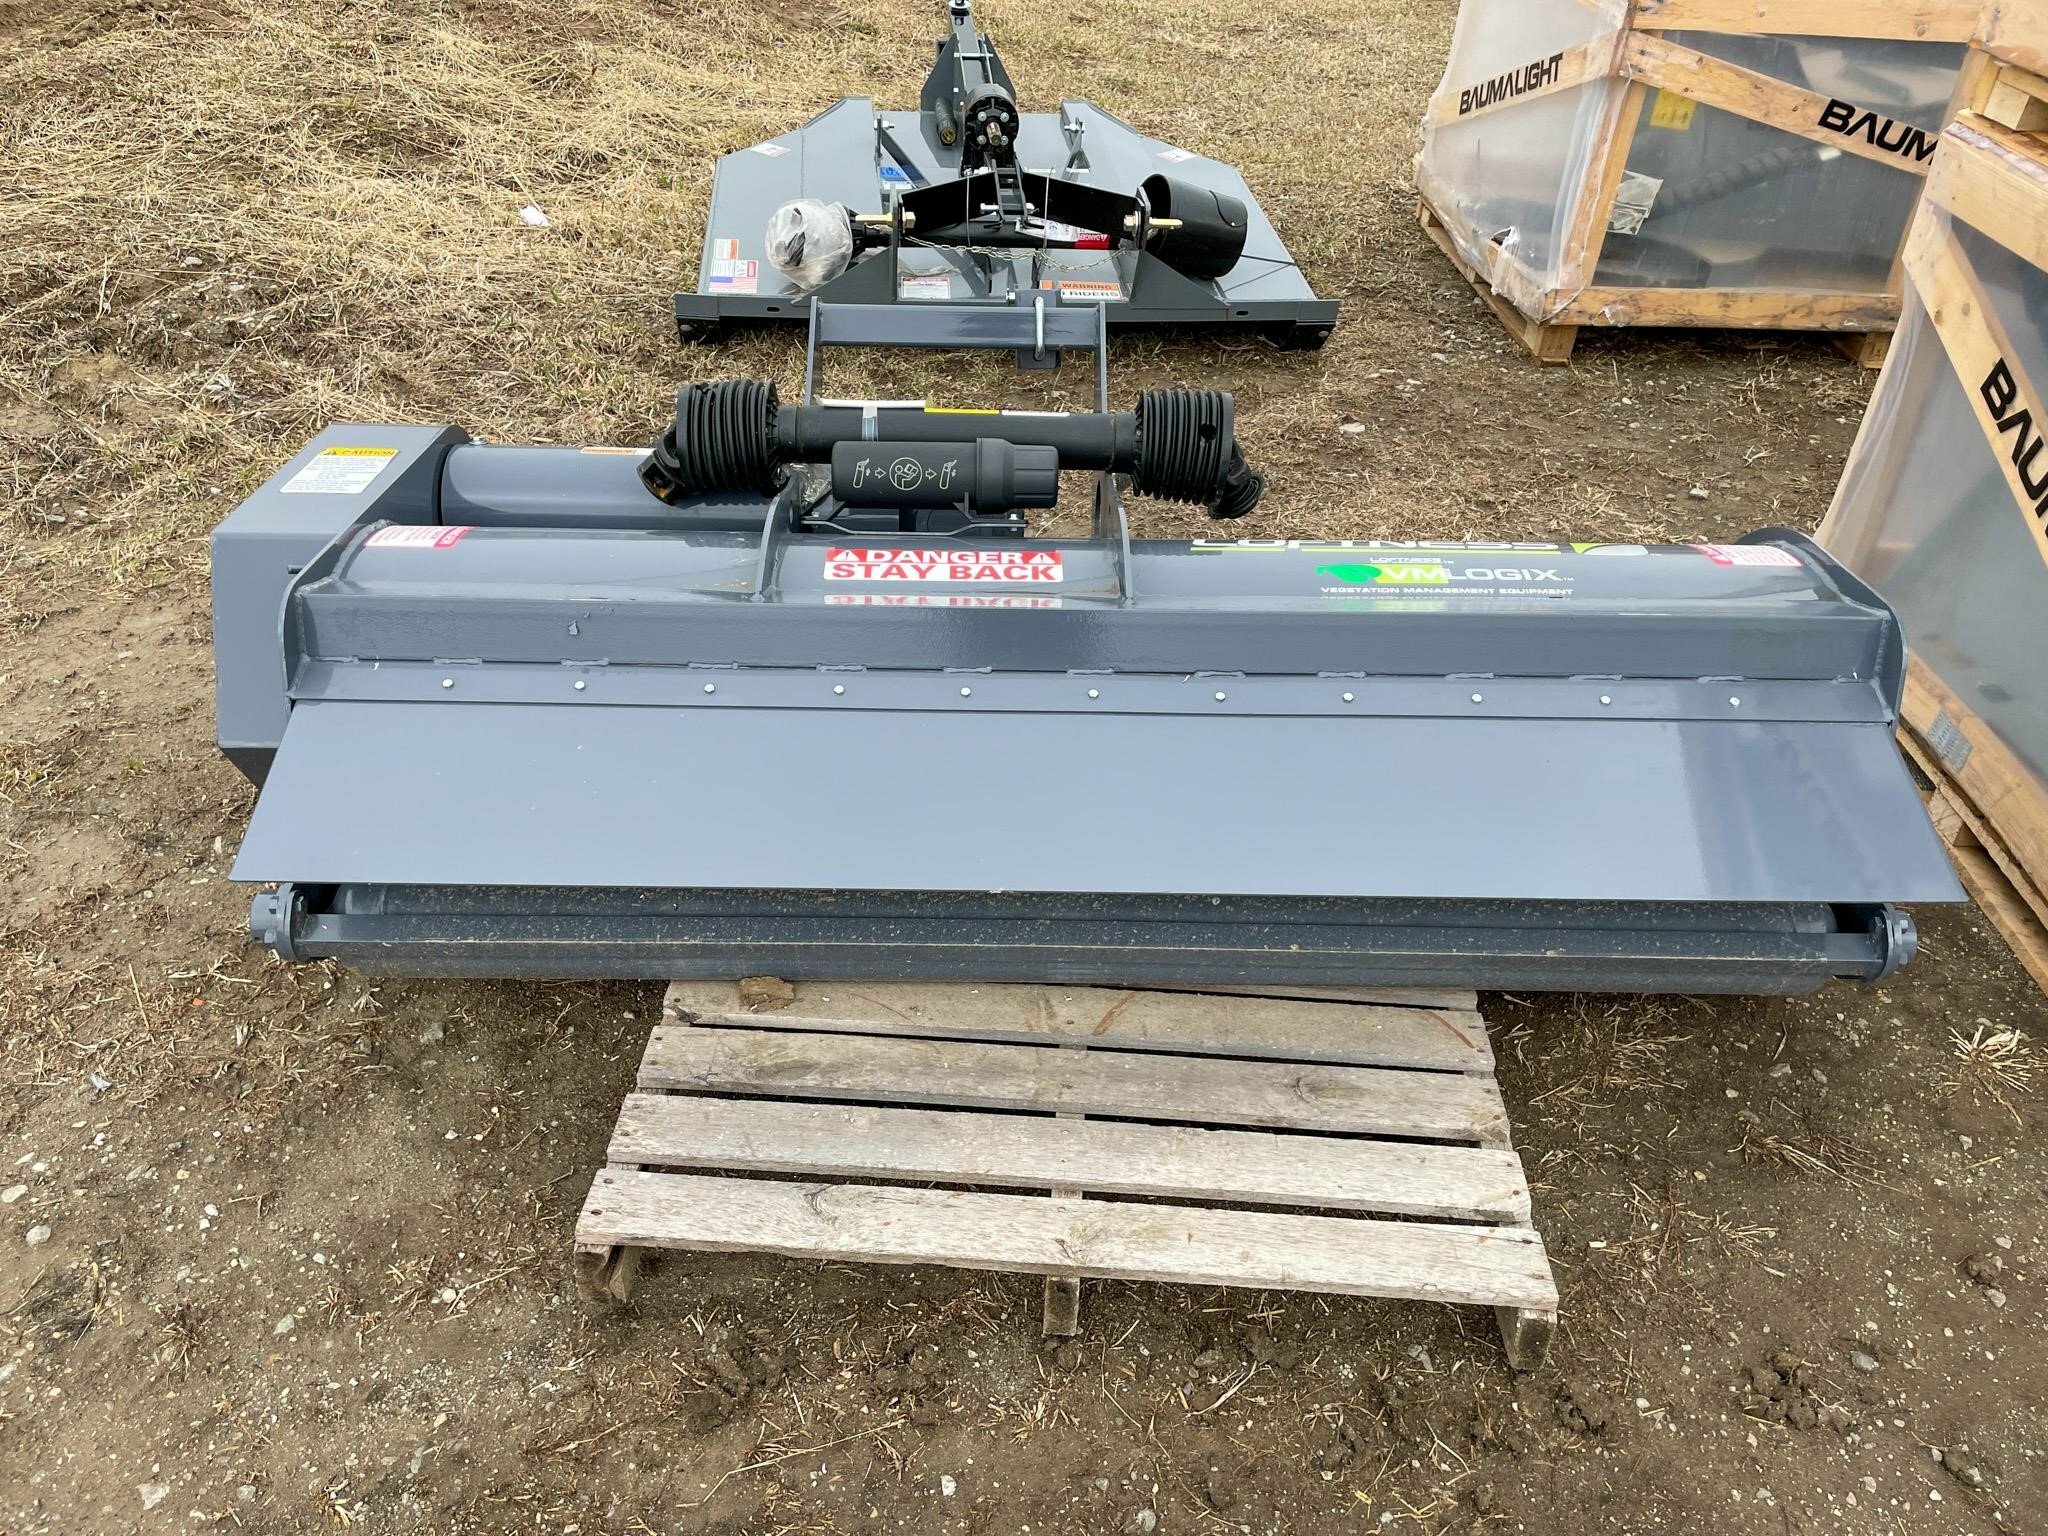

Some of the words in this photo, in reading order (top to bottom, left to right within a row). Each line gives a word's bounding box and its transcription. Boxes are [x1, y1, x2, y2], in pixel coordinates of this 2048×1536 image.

[1459, 52, 1563, 115] BAUMALIGHT
[1980, 357, 2048, 538] BAU
[832, 563, 936, 579] STAY
[949, 565, 1056, 581] BACK
[867, 550, 1023, 565] DANGER
